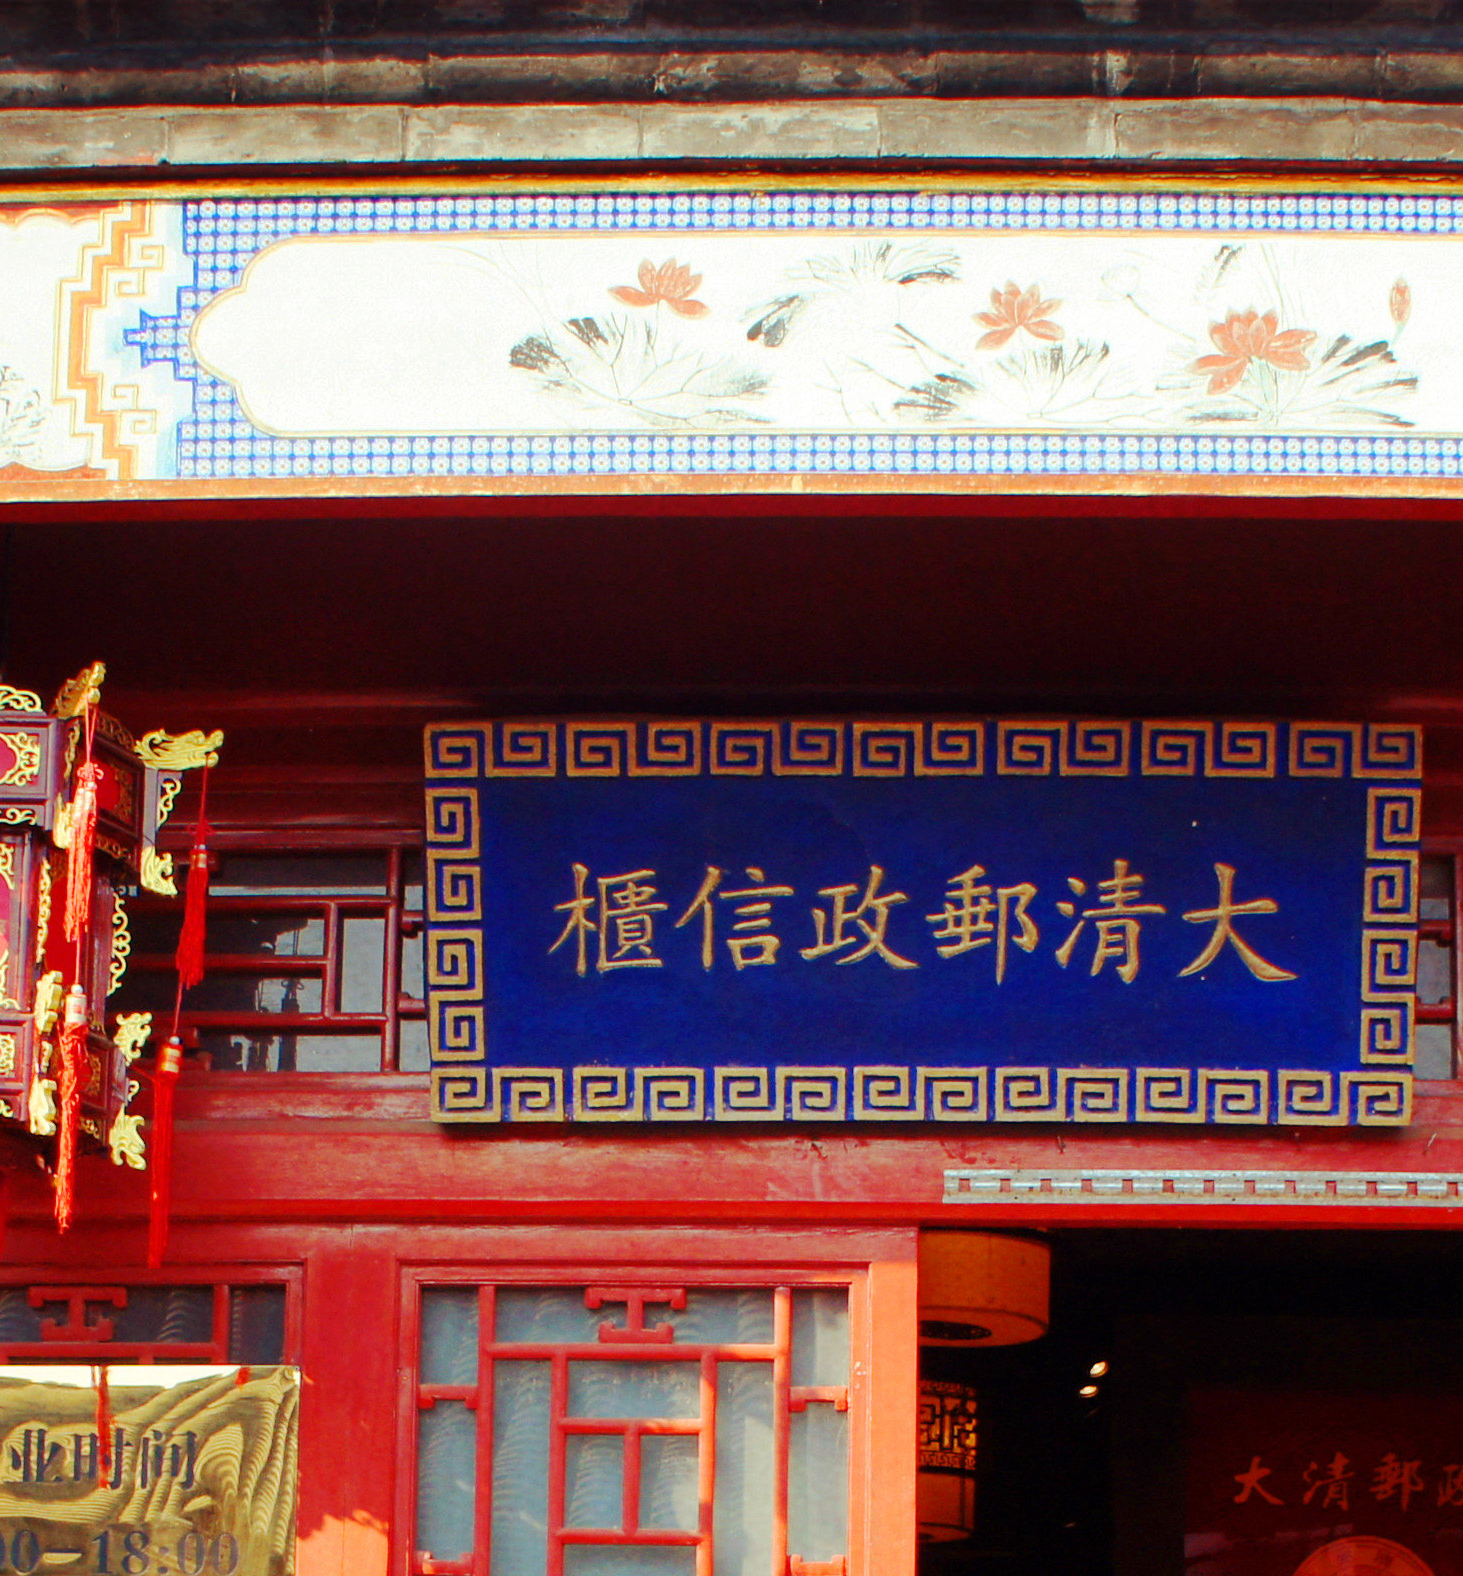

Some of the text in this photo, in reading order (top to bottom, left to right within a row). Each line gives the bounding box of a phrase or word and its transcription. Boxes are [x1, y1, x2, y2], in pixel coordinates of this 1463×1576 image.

[547, 858, 1300, 985] 大清郵政信櫃
